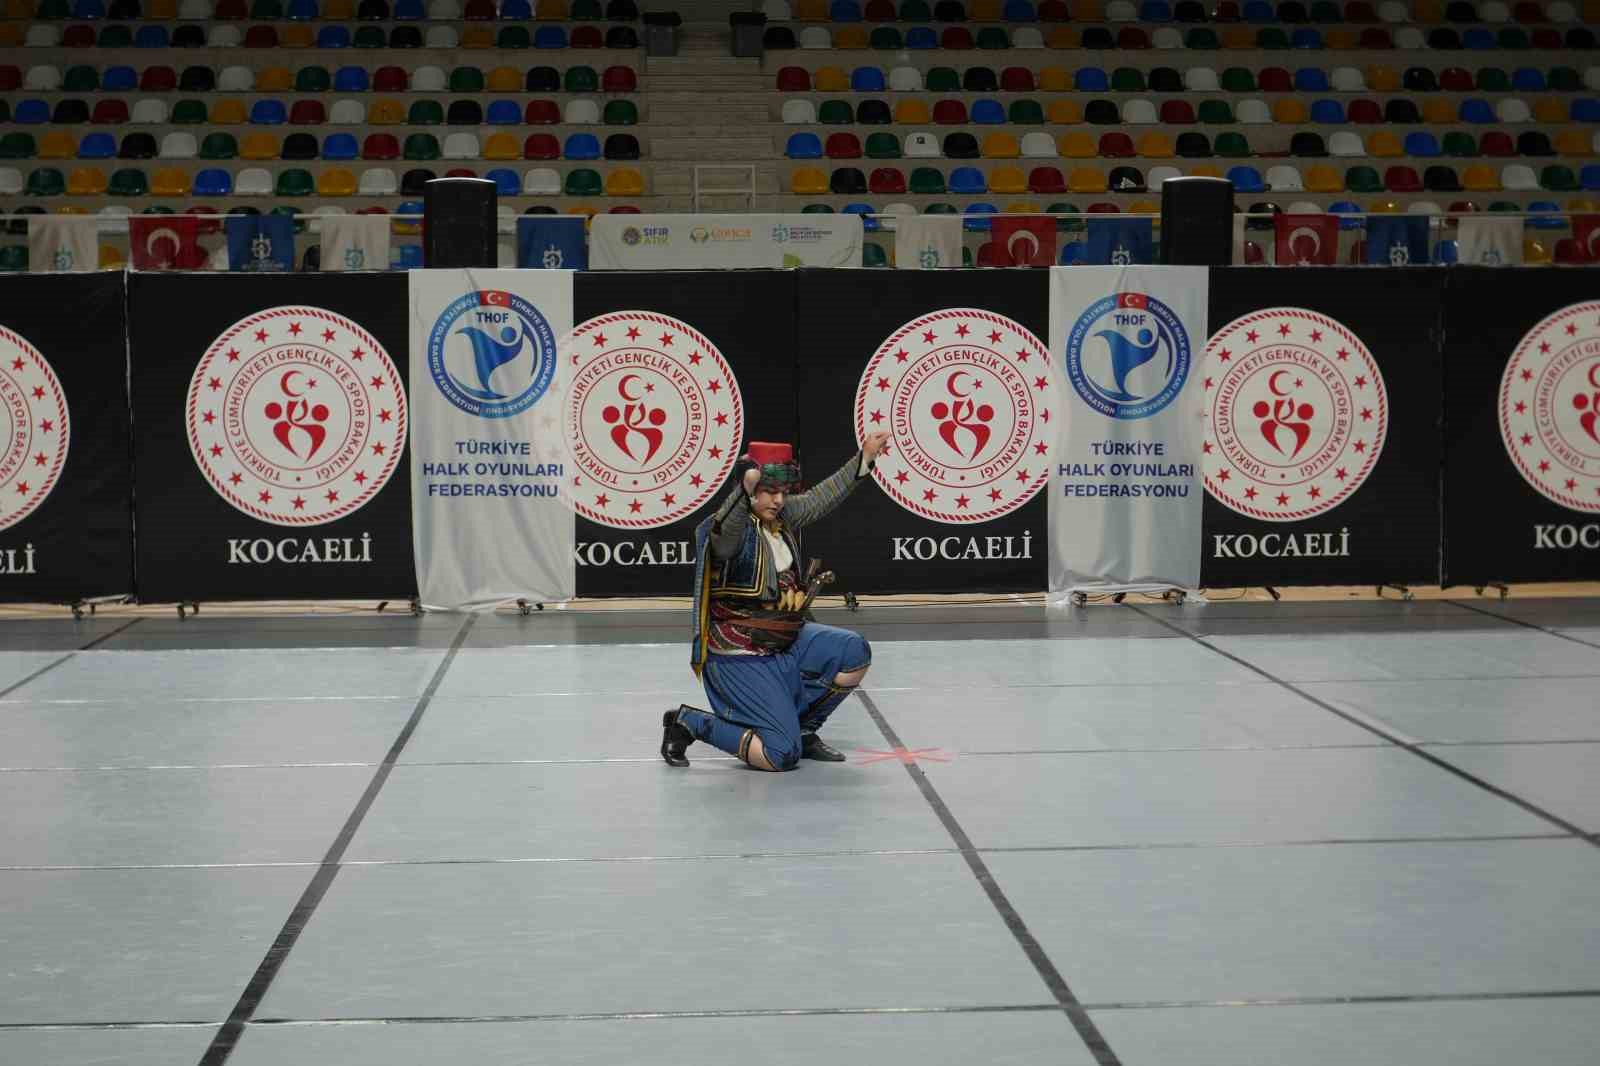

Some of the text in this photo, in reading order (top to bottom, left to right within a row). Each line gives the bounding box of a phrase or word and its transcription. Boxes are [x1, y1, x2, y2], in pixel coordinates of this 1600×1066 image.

[477, 312, 509, 323] THOF
[1114, 315, 1146, 326] THOF
[274, 347, 336, 369] GENÇLİK
[942, 348, 1001, 371] GENÇLİK
[1264, 348, 1321, 371] GENÇLİK
[333, 362, 353, 383] VE
[997, 364, 1017, 383] VE
[1317, 364, 1337, 384] VE
[228, 352, 274, 438] CUMHURİYETİ
[345, 379, 366, 416] SPOR
[894, 353, 941, 437] CUMHURİYETİ
[1010, 381, 1029, 417] SPOR
[1217, 352, 1264, 436] CUMHURİYETİ
[1329, 379, 1349, 416] SPOR
[8, 392, 26, 428] SPOR
[571, 441, 619, 486] TÜRKİYE
[613, 352, 673, 375] GENÇLİK
[669, 367, 688, 387] VE
[682, 384, 702, 420] SPOR
[233, 438, 282, 483] TÜRKİYE
[456, 440, 531, 455] TÜRKİYE
[899, 437, 947, 482] TÜRKİYE
[1091, 440, 1164, 456] TÜRKİYE
[1221, 435, 1268, 479] TÜRKİYE
[423, 463, 564, 476] HALK OYUNLARI
[1058, 463, 1194, 477] HALK OYUNLARI
[428, 484, 558, 497] FEDERASYONU
[1064, 484, 1189, 497] FEDERASYONU
[227, 531, 373, 564] KOCAELİ
[572, 541, 697, 567] KOCAEL
[892, 529, 1033, 561] KOCAELİ
[1213, 526, 1351, 558] KOCAELİ
